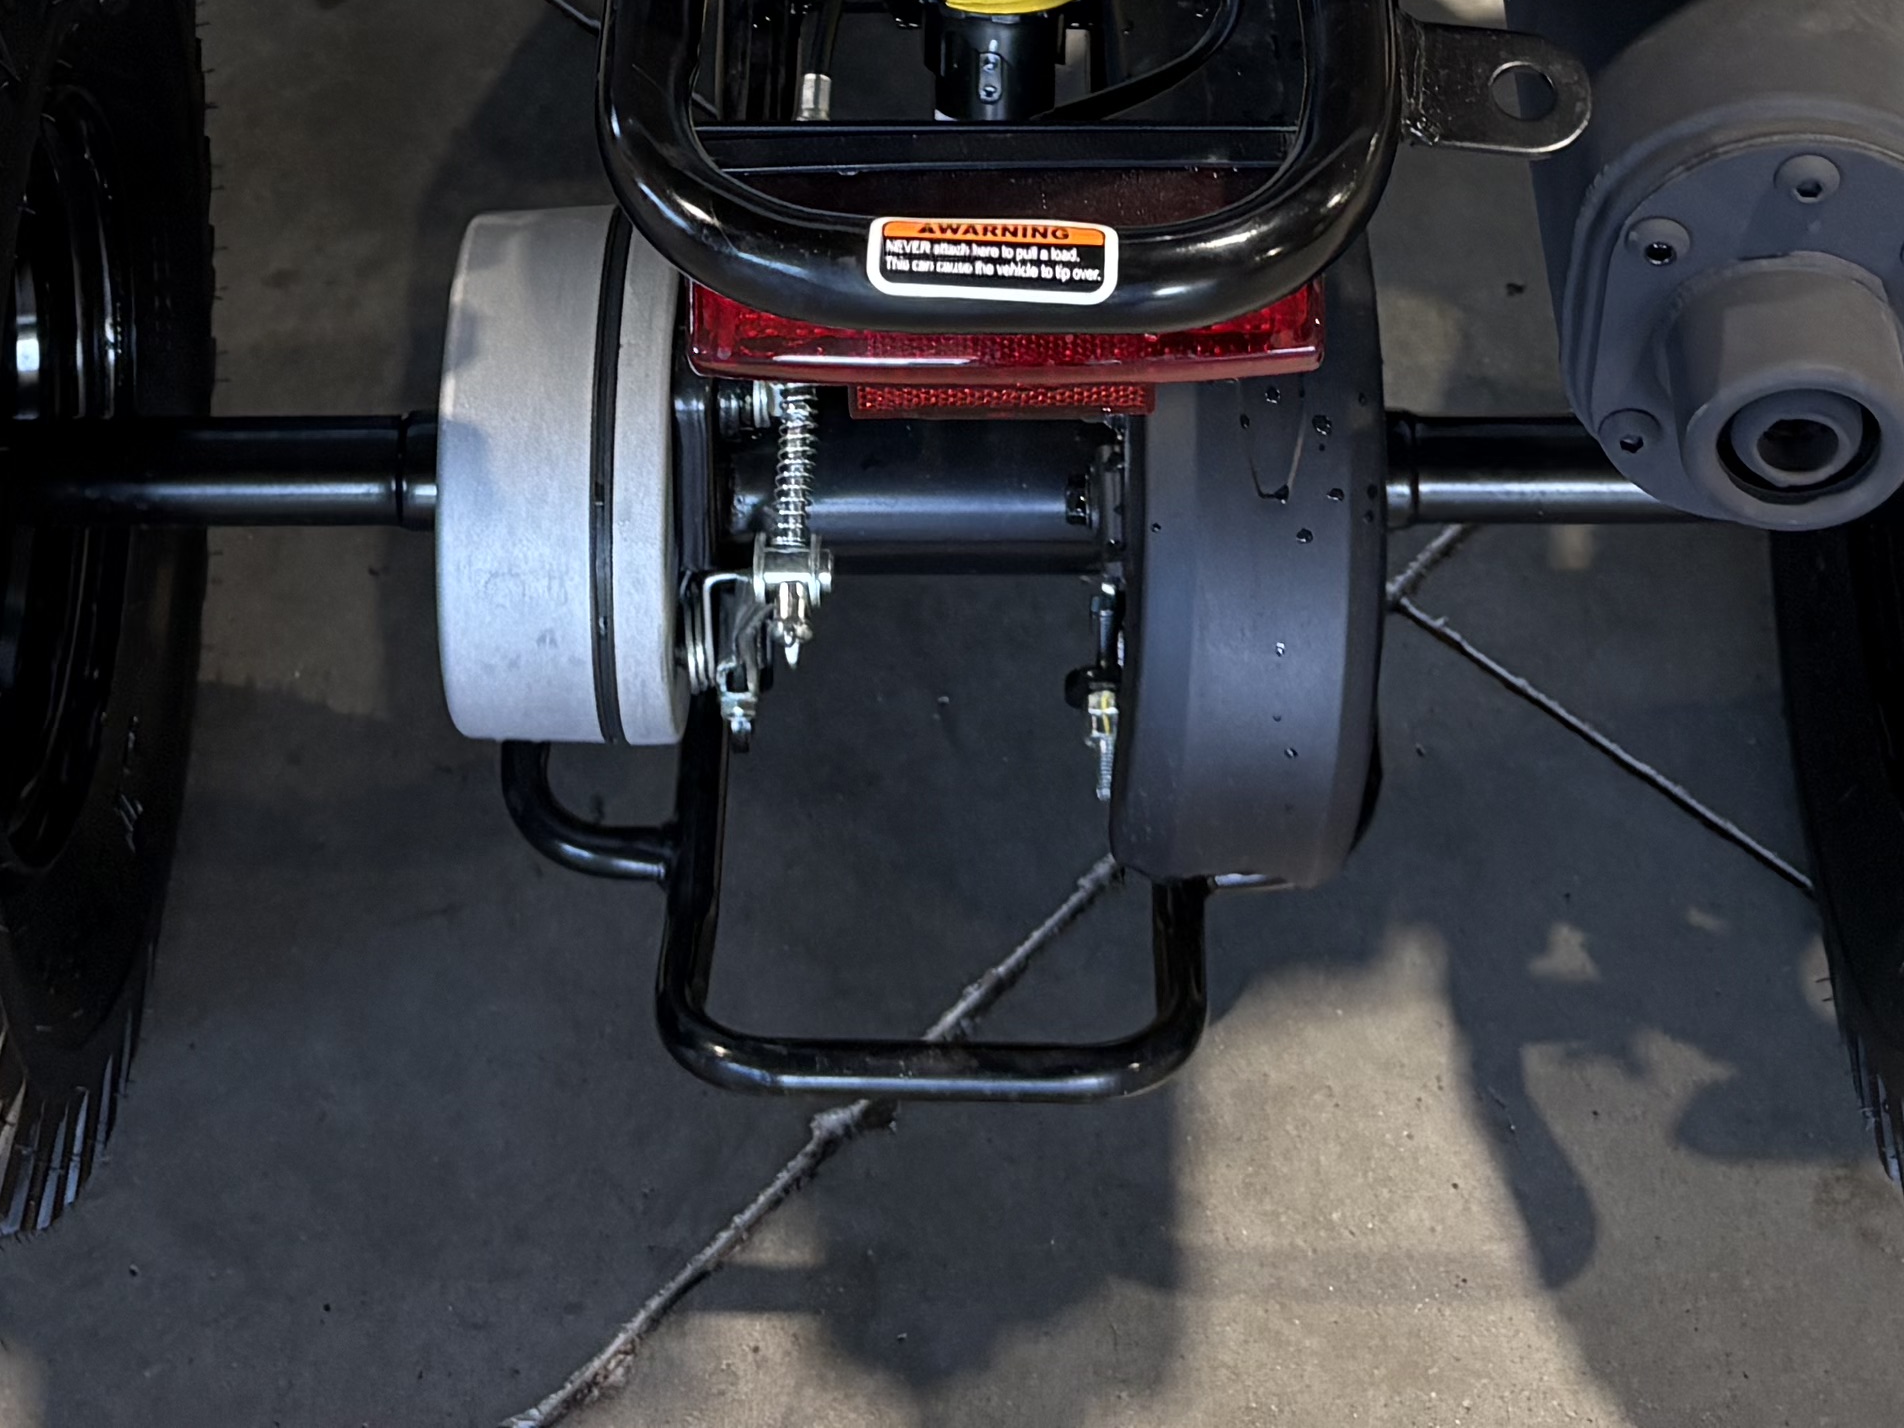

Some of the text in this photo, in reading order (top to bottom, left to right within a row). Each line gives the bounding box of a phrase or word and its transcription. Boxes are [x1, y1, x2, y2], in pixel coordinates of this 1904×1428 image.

[940, 223, 1070, 240] WARNING
[885, 240, 1080, 262] NEVER attach here to pull a load.
[886, 256, 1101, 282] This can cause the vehicle to tip over.
